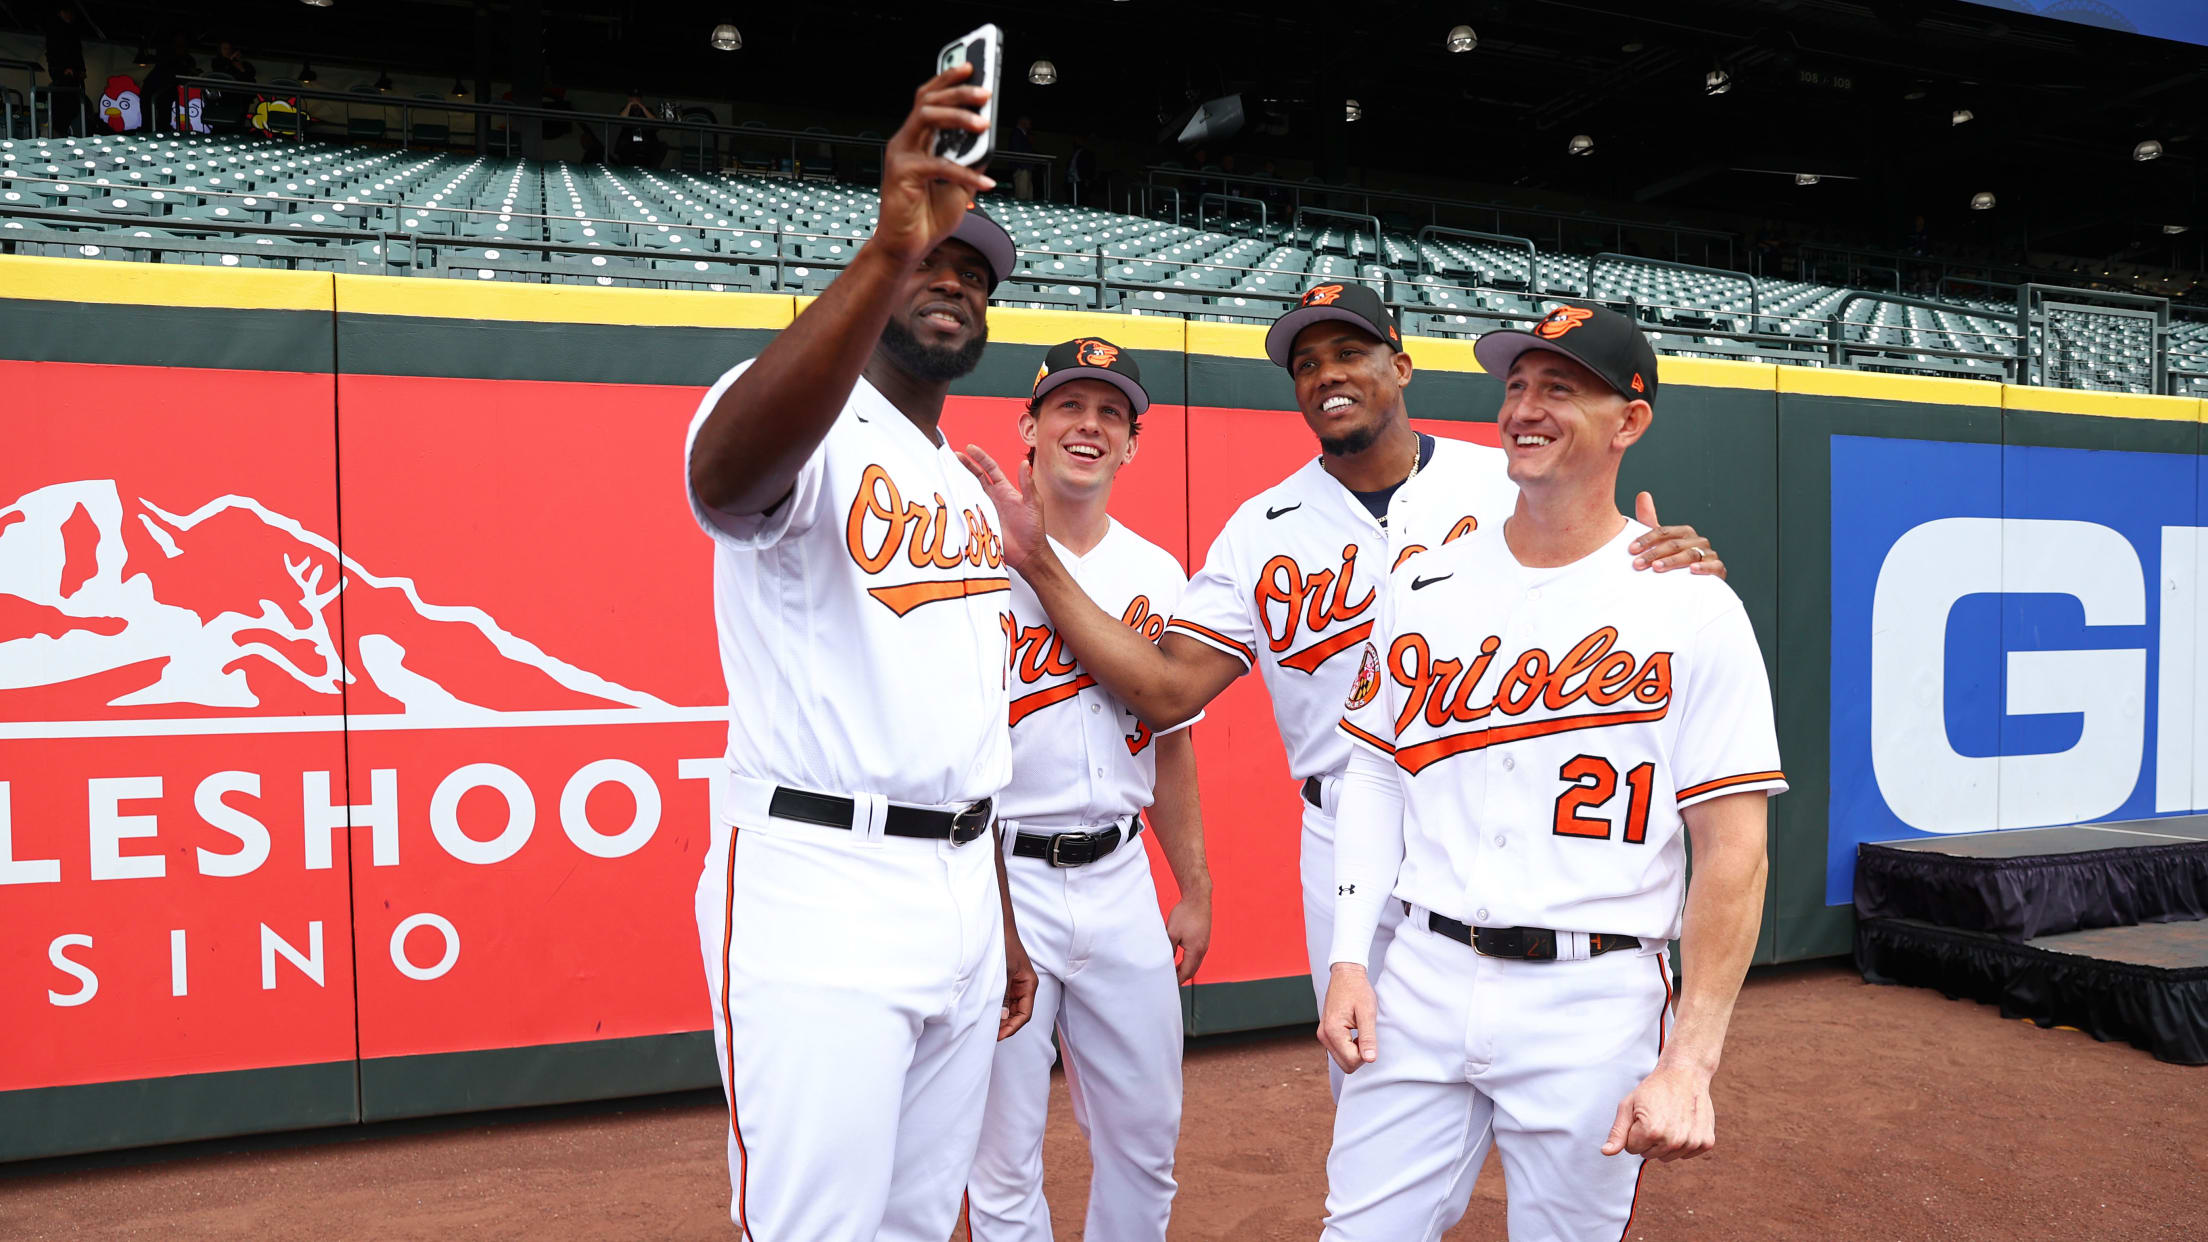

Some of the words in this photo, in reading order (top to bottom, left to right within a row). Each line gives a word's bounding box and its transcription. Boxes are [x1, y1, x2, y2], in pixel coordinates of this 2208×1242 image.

[1387, 626, 1674, 741] Orioles
[1871, 517, 2208, 834] G
[1552, 753, 1656, 845] 21
[47, 912, 461, 1007] SINO
